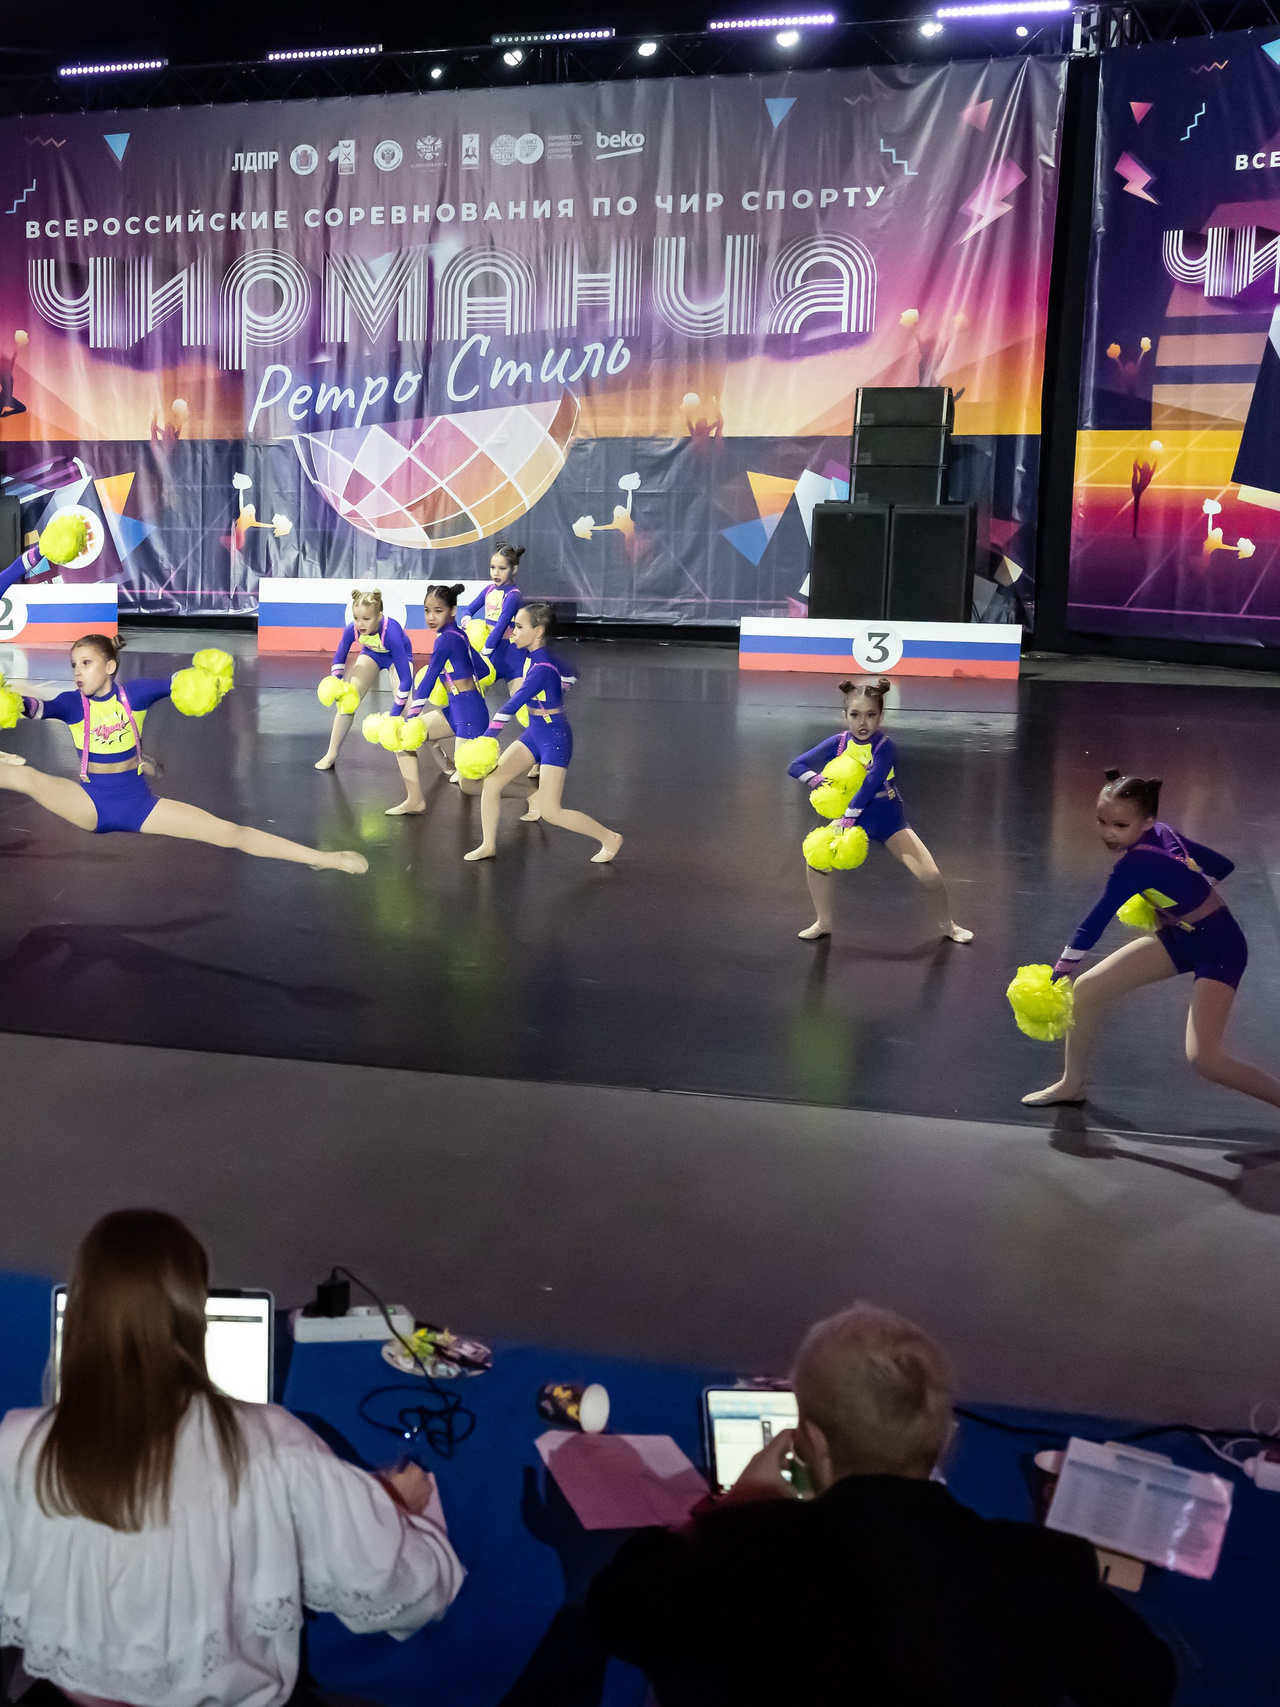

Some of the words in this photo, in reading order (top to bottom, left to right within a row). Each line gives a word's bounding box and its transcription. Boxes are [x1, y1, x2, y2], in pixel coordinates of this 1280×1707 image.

[595, 130, 646, 149] beko
[231, 151, 279, 173] ЛДПР
[25, 209, 289, 239] ВСЕРОССИЙСКИЕ
[304, 198, 574, 228] СОРЕВНОВАНИЯ
[593, 196, 638, 217] ПО
[655, 193, 725, 214] ЧИР
[741, 186, 886, 212] СПОРТУ
[247, 364, 423, 434] Ретро
[446, 333, 632, 402] Стиль
[865, 632, 890, 663] 3
